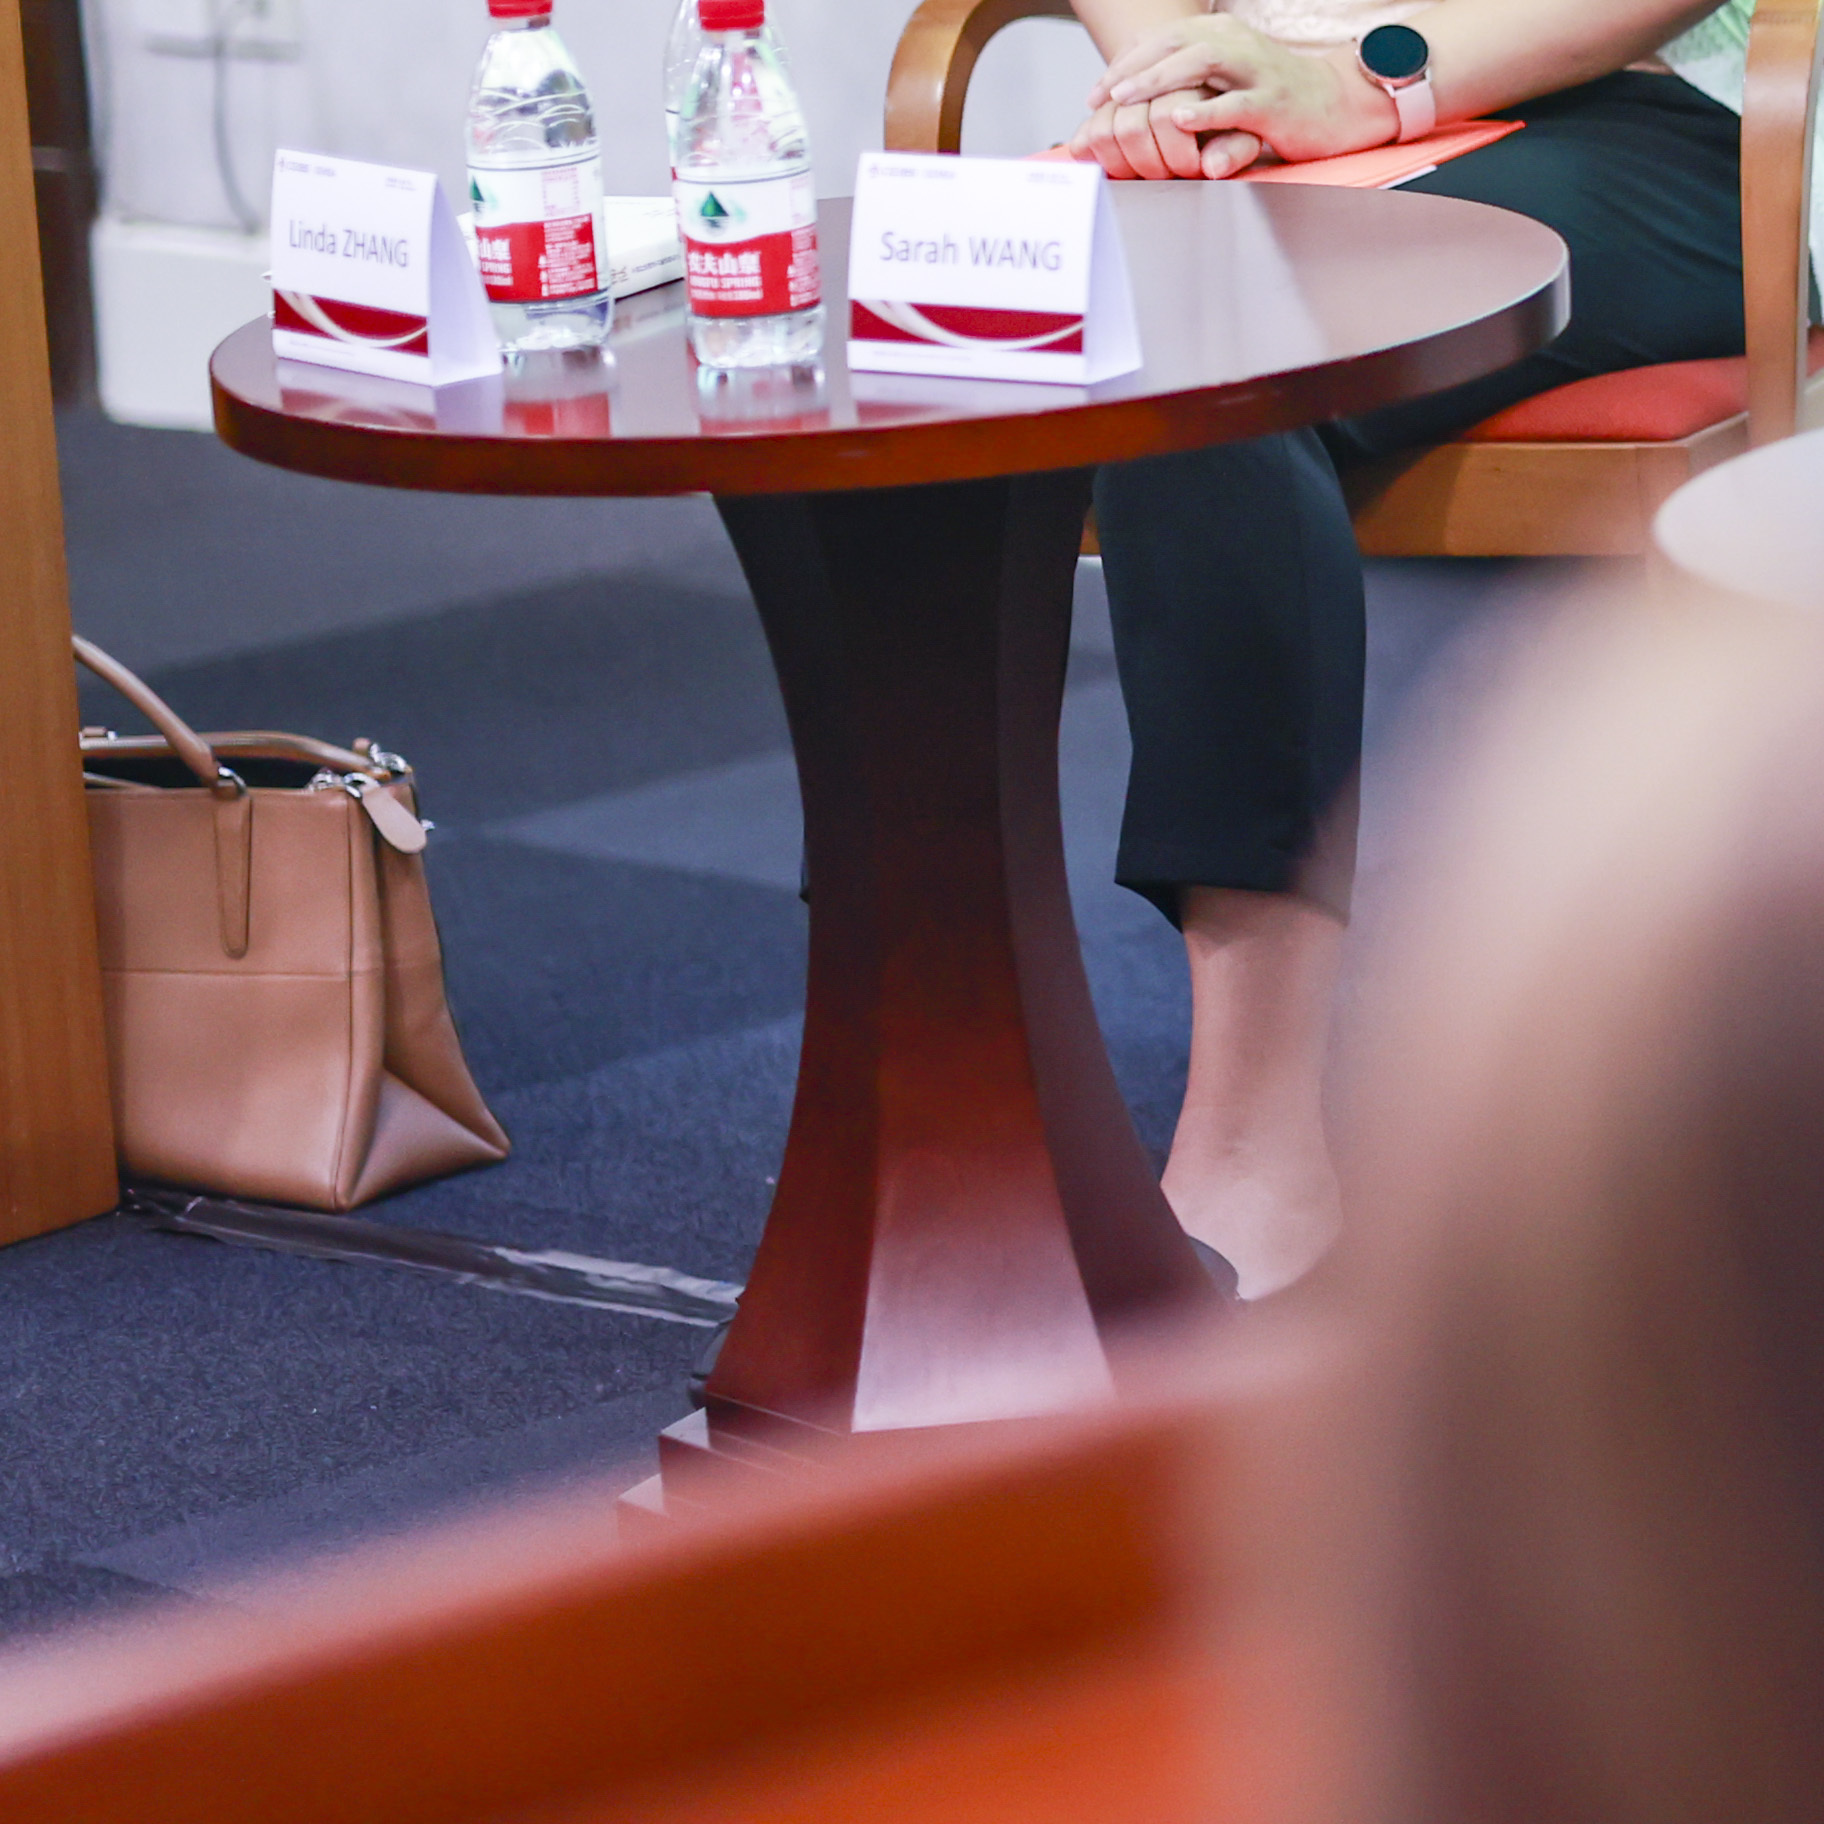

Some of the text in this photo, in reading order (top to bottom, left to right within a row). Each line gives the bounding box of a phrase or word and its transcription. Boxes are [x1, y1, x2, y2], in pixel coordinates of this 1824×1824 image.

[289, 219, 408, 268] Linda ZHANG
[880, 231, 1062, 272] Sarah WANG
